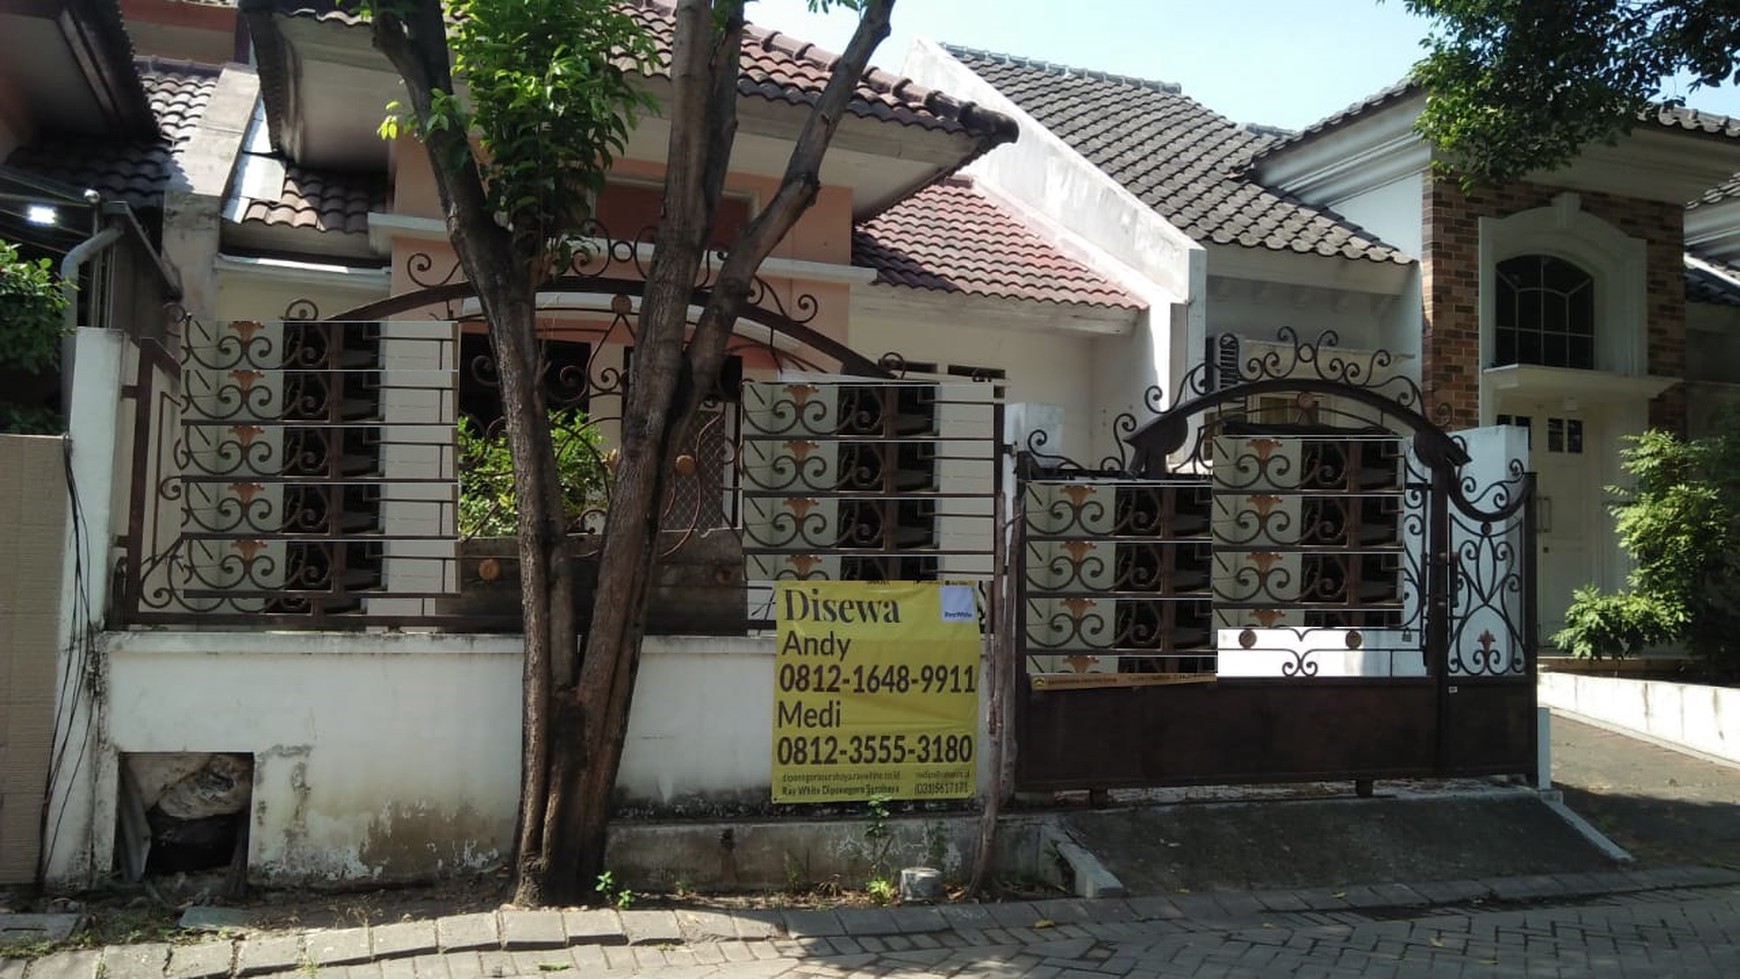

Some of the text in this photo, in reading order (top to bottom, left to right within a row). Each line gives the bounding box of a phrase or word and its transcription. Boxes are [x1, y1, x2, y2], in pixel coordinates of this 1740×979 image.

[784, 588, 901, 624] Disewa
[781, 630, 852, 662] Andy
[779, 663, 976, 694] 0812-1648-9911
[777, 700, 842, 729] Medi
[777, 734, 973, 766] 0812-3555-3180
